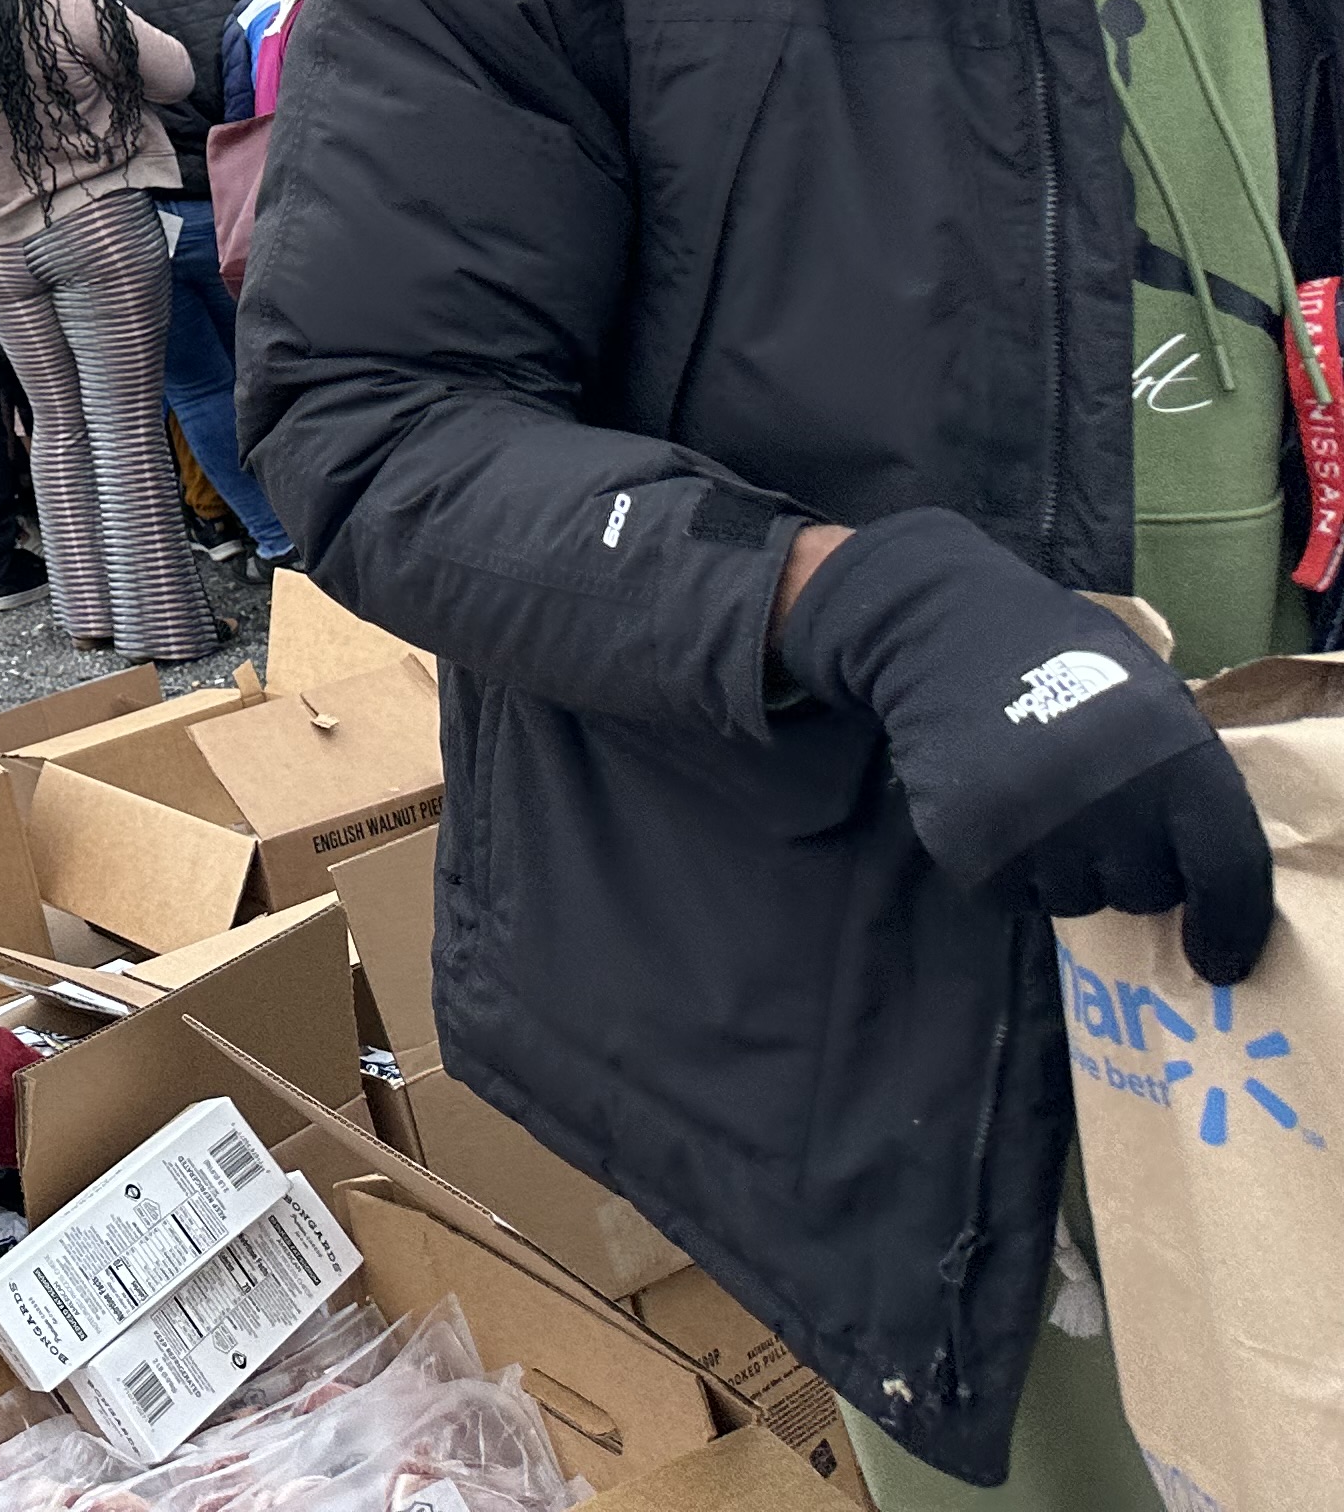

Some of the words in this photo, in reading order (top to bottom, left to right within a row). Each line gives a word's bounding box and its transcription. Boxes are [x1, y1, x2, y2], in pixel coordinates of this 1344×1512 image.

[1309, 398, 1340, 535] NISSAN
[1020, 658, 1069, 689] THE
[1003, 668, 1079, 725] NORTH
[1033, 683, 1093, 724] FACE
[313, 822, 365, 854] ENGLISH
[365, 805, 417, 838] WALNUT
[176, 1154, 214, 1203] REFRIGERATED
[217, 1179, 226, 1188] LB
[211, 1201, 226, 1220] KEEP
[282, 1193, 342, 1273] BONGARDS
[52, 1280, 80, 1316] AMERICAN
[90, 1275, 106, 1295] Facts
[8, 1281, 70, 1366] BONGARDS
[61, 1307, 86, 1339] REDUCED
[102, 1292, 125, 1321] Nutrition
[153, 1330, 167, 1348] KEEP
[164, 1347, 202, 1399] REFRIGERATED
[762, 1345, 788, 1367] PULL
